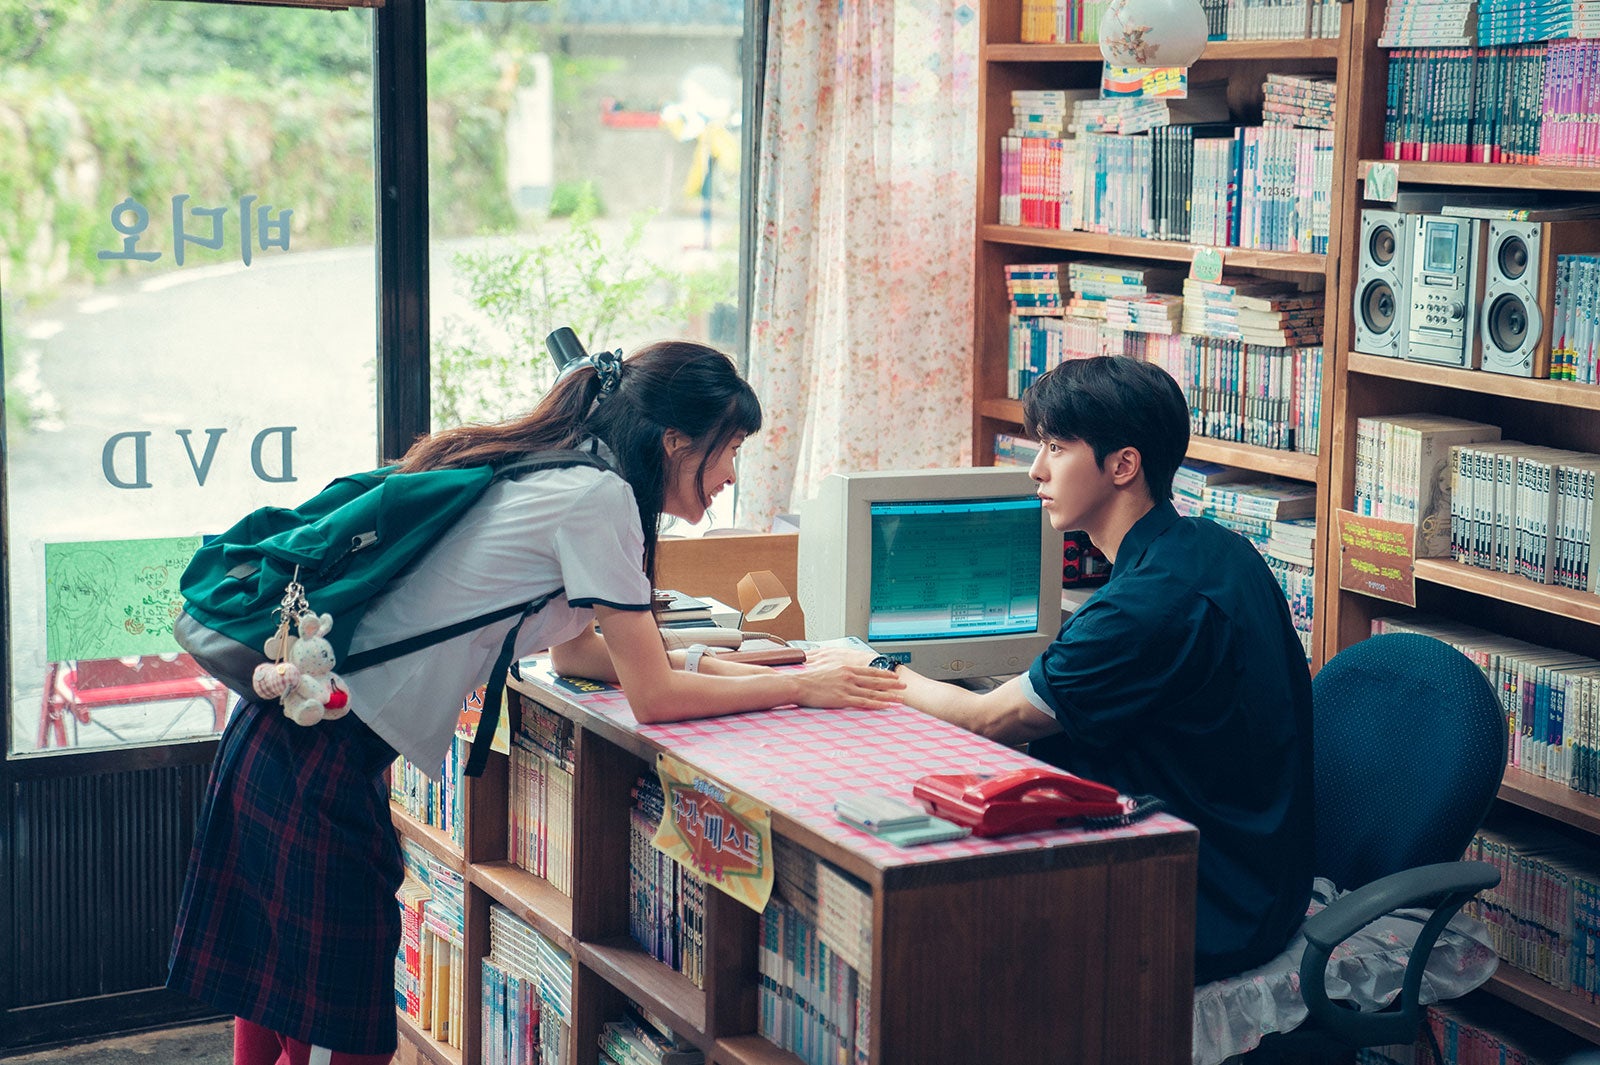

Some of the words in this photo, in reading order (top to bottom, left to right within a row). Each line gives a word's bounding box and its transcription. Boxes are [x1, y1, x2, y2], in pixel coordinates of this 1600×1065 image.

[1263, 187, 1266, 196] 1
[1268, 187, 1272, 196] 2
[1274, 187, 1279, 196] 3
[1280, 188, 1285, 197] 4
[1286, 188, 1291, 197] 5
[1527, 726, 1533, 736] 2
[1555, 734, 1561, 744] 2
